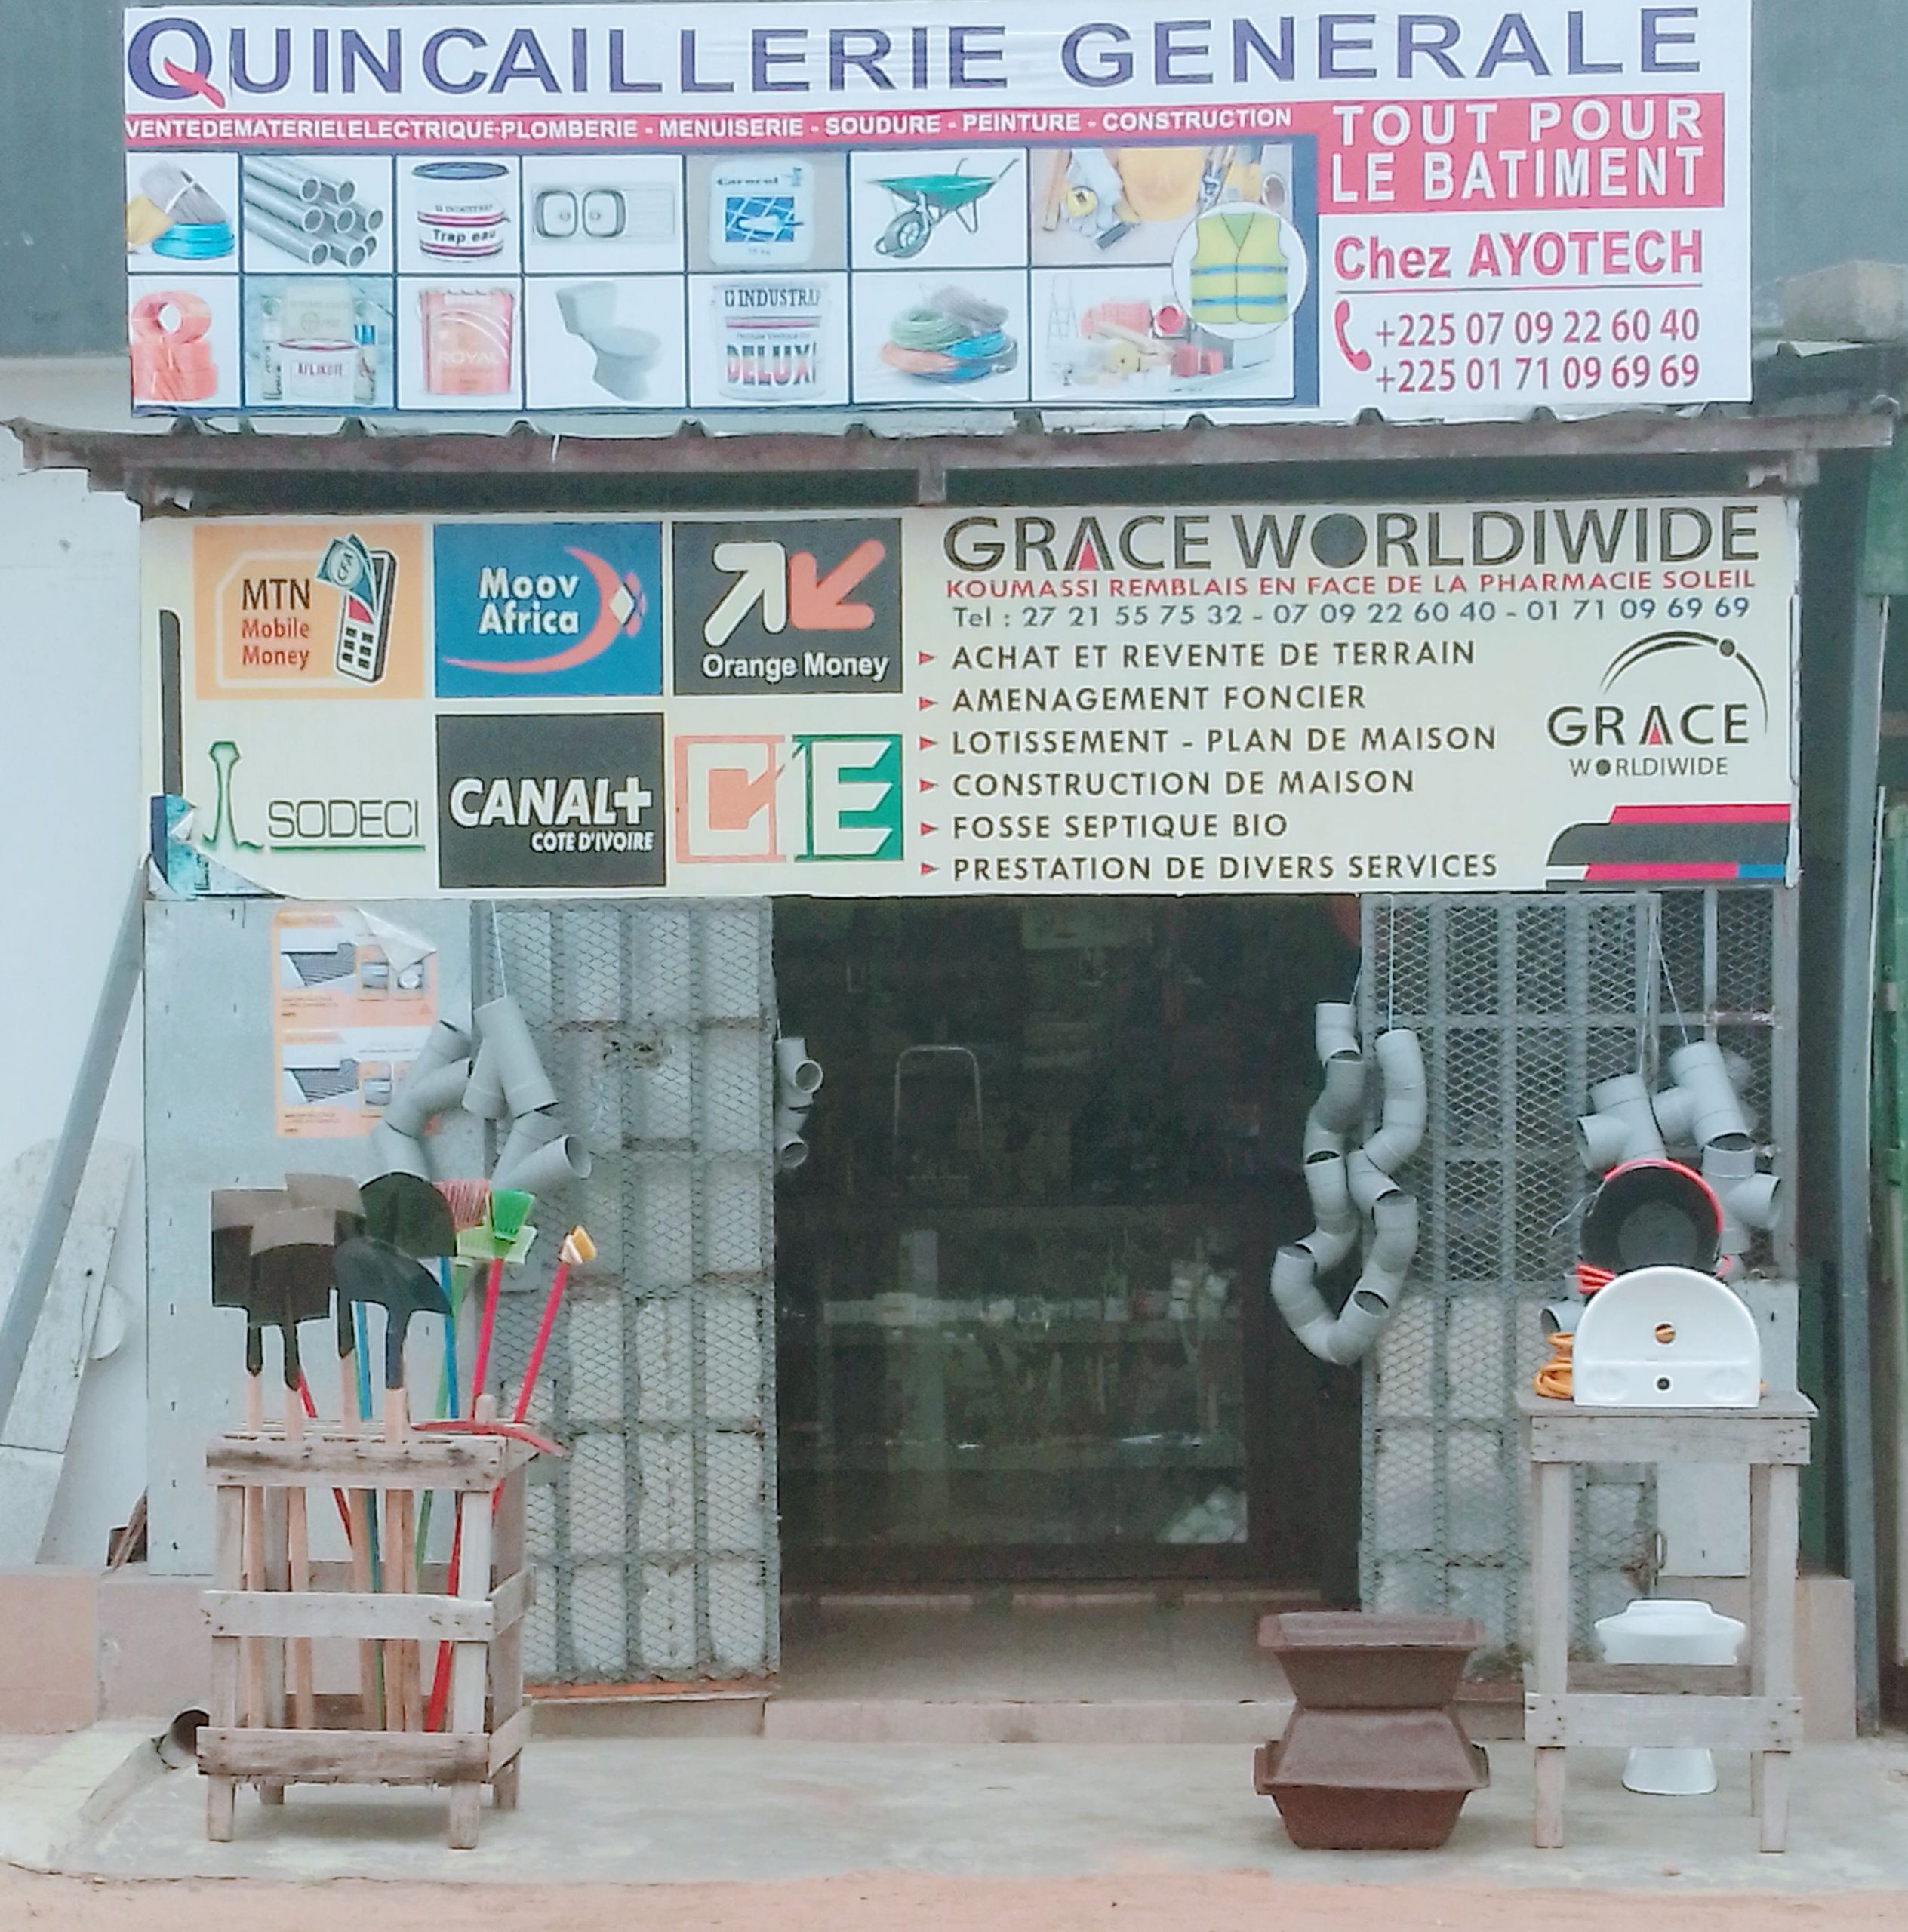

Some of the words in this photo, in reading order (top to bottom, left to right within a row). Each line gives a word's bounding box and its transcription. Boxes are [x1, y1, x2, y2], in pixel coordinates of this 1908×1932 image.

[127, 17, 1008, 109] QUINCAILLERIE
[1060, 7, 1700, 88] GENERALE
[659, 117, 803, 139] MENUISERIE
[825, 114, 940, 136] SOUDURE
[962, 112, 1080, 133] PEINTURE
[1103, 108, 1292, 131] CONSTRUCTION
[1333, 103, 1497, 146] TOUT
[1530, 99, 1703, 142] POUR
[1332, 153, 1395, 202] LE
[1423, 146, 1703, 201] BATIMENT
[433, 229, 466, 245] Trap
[471, 229, 496, 242] eau
[1334, 235, 1451, 280] Chez
[1468, 229, 1703, 278] AYOTECH
[1377, 312, 1455, 347] +225
[1466, 312, 1503, 346] 07
[1515, 311, 1552, 345] 09
[1564, 311, 1601, 344] 22
[1611, 309, 1650, 343] 60
[1660, 308, 1698, 341] 40
[1377, 358, 1455, 392] +225
[1466, 358, 1500, 391] 01
[1516, 358, 1549, 390] 71
[1564, 356, 1601, 389] 09
[1612, 355, 1650, 389] 69
[1660, 354, 1698, 387] 69
[943, 515, 1211, 571] GRACE
[1231, 506, 1759, 569] WORLDIWIDE
[242, 578, 310, 611] MTN
[479, 568, 579, 600] Moov
[946, 579, 1098, 598] KOUMASSI
[1110, 577, 1247, 597] REMBLAIS
[1260, 577, 1295, 595] EN
[1307, 575, 1374, 595] FACE
[1387, 574, 1421, 594] DE
[1434, 574, 1467, 593] LA
[1480, 571, 1650, 592] PHARMACIE
[1663, 569, 1755, 589] SOLEIL
[479, 601, 579, 635] Africa
[1022, 606, 1054, 627] 27
[1069, 606, 1097, 626] 21
[1116, 605, 1148, 626] 55
[1160, 605, 1195, 626] 75
[1208, 605, 1242, 626] 32
[1273, 604, 1307, 625] 07
[1320, 604, 1356, 625] 09
[1369, 603, 1402, 623] 22
[1414, 601, 1449, 623] 60
[1459, 601, 1495, 622] 40
[1527, 601, 1557, 621] 01
[1574, 600, 1604, 620] 71
[1620, 598, 1656, 619] 09
[1668, 597, 1703, 618] 69
[1715, 597, 1750, 617] 69
[242, 618, 309, 638] Mobile
[242, 645, 309, 671] Money
[702, 652, 797, 682] Orange
[803, 651, 889, 681] Money
[952, 645, 1060, 670] ACHAT
[1075, 645, 1107, 669] ET
[1122, 643, 1265, 669] REVENTE
[1281, 643, 1319, 666] DE
[1333, 640, 1474, 666] TERRAIN
[952, 686, 1209, 712] AMENAGEMENT
[1224, 685, 1365, 709] FONCIER
[952, 730, 1168, 755] LOTISSEMENT
[1208, 728, 1291, 753] PLAN
[1306, 728, 1346, 752] DE
[1361, 725, 1496, 752] MAISON
[1547, 703, 1749, 747] GRACE
[1570, 757, 1728, 777] WORLDIWIDE
[685, 739, 895, 858] CIE
[952, 771, 1209, 797] CONSTRUCTION
[1225, 771, 1264, 795] DE
[1279, 769, 1414, 795] MAISON
[450, 776, 651, 827] CANAL+
[268, 800, 418, 838] SODECI
[952, 815, 1050, 840] FOSSE
[1065, 814, 1217, 841] SEPTIQUE
[1233, 814, 1288, 838] BIO
[952, 857, 1150, 881] PRESTATION
[1166, 857, 1205, 880] DE
[1220, 856, 1334, 880] DIVERS
[1348, 854, 1498, 878] SERVICES
